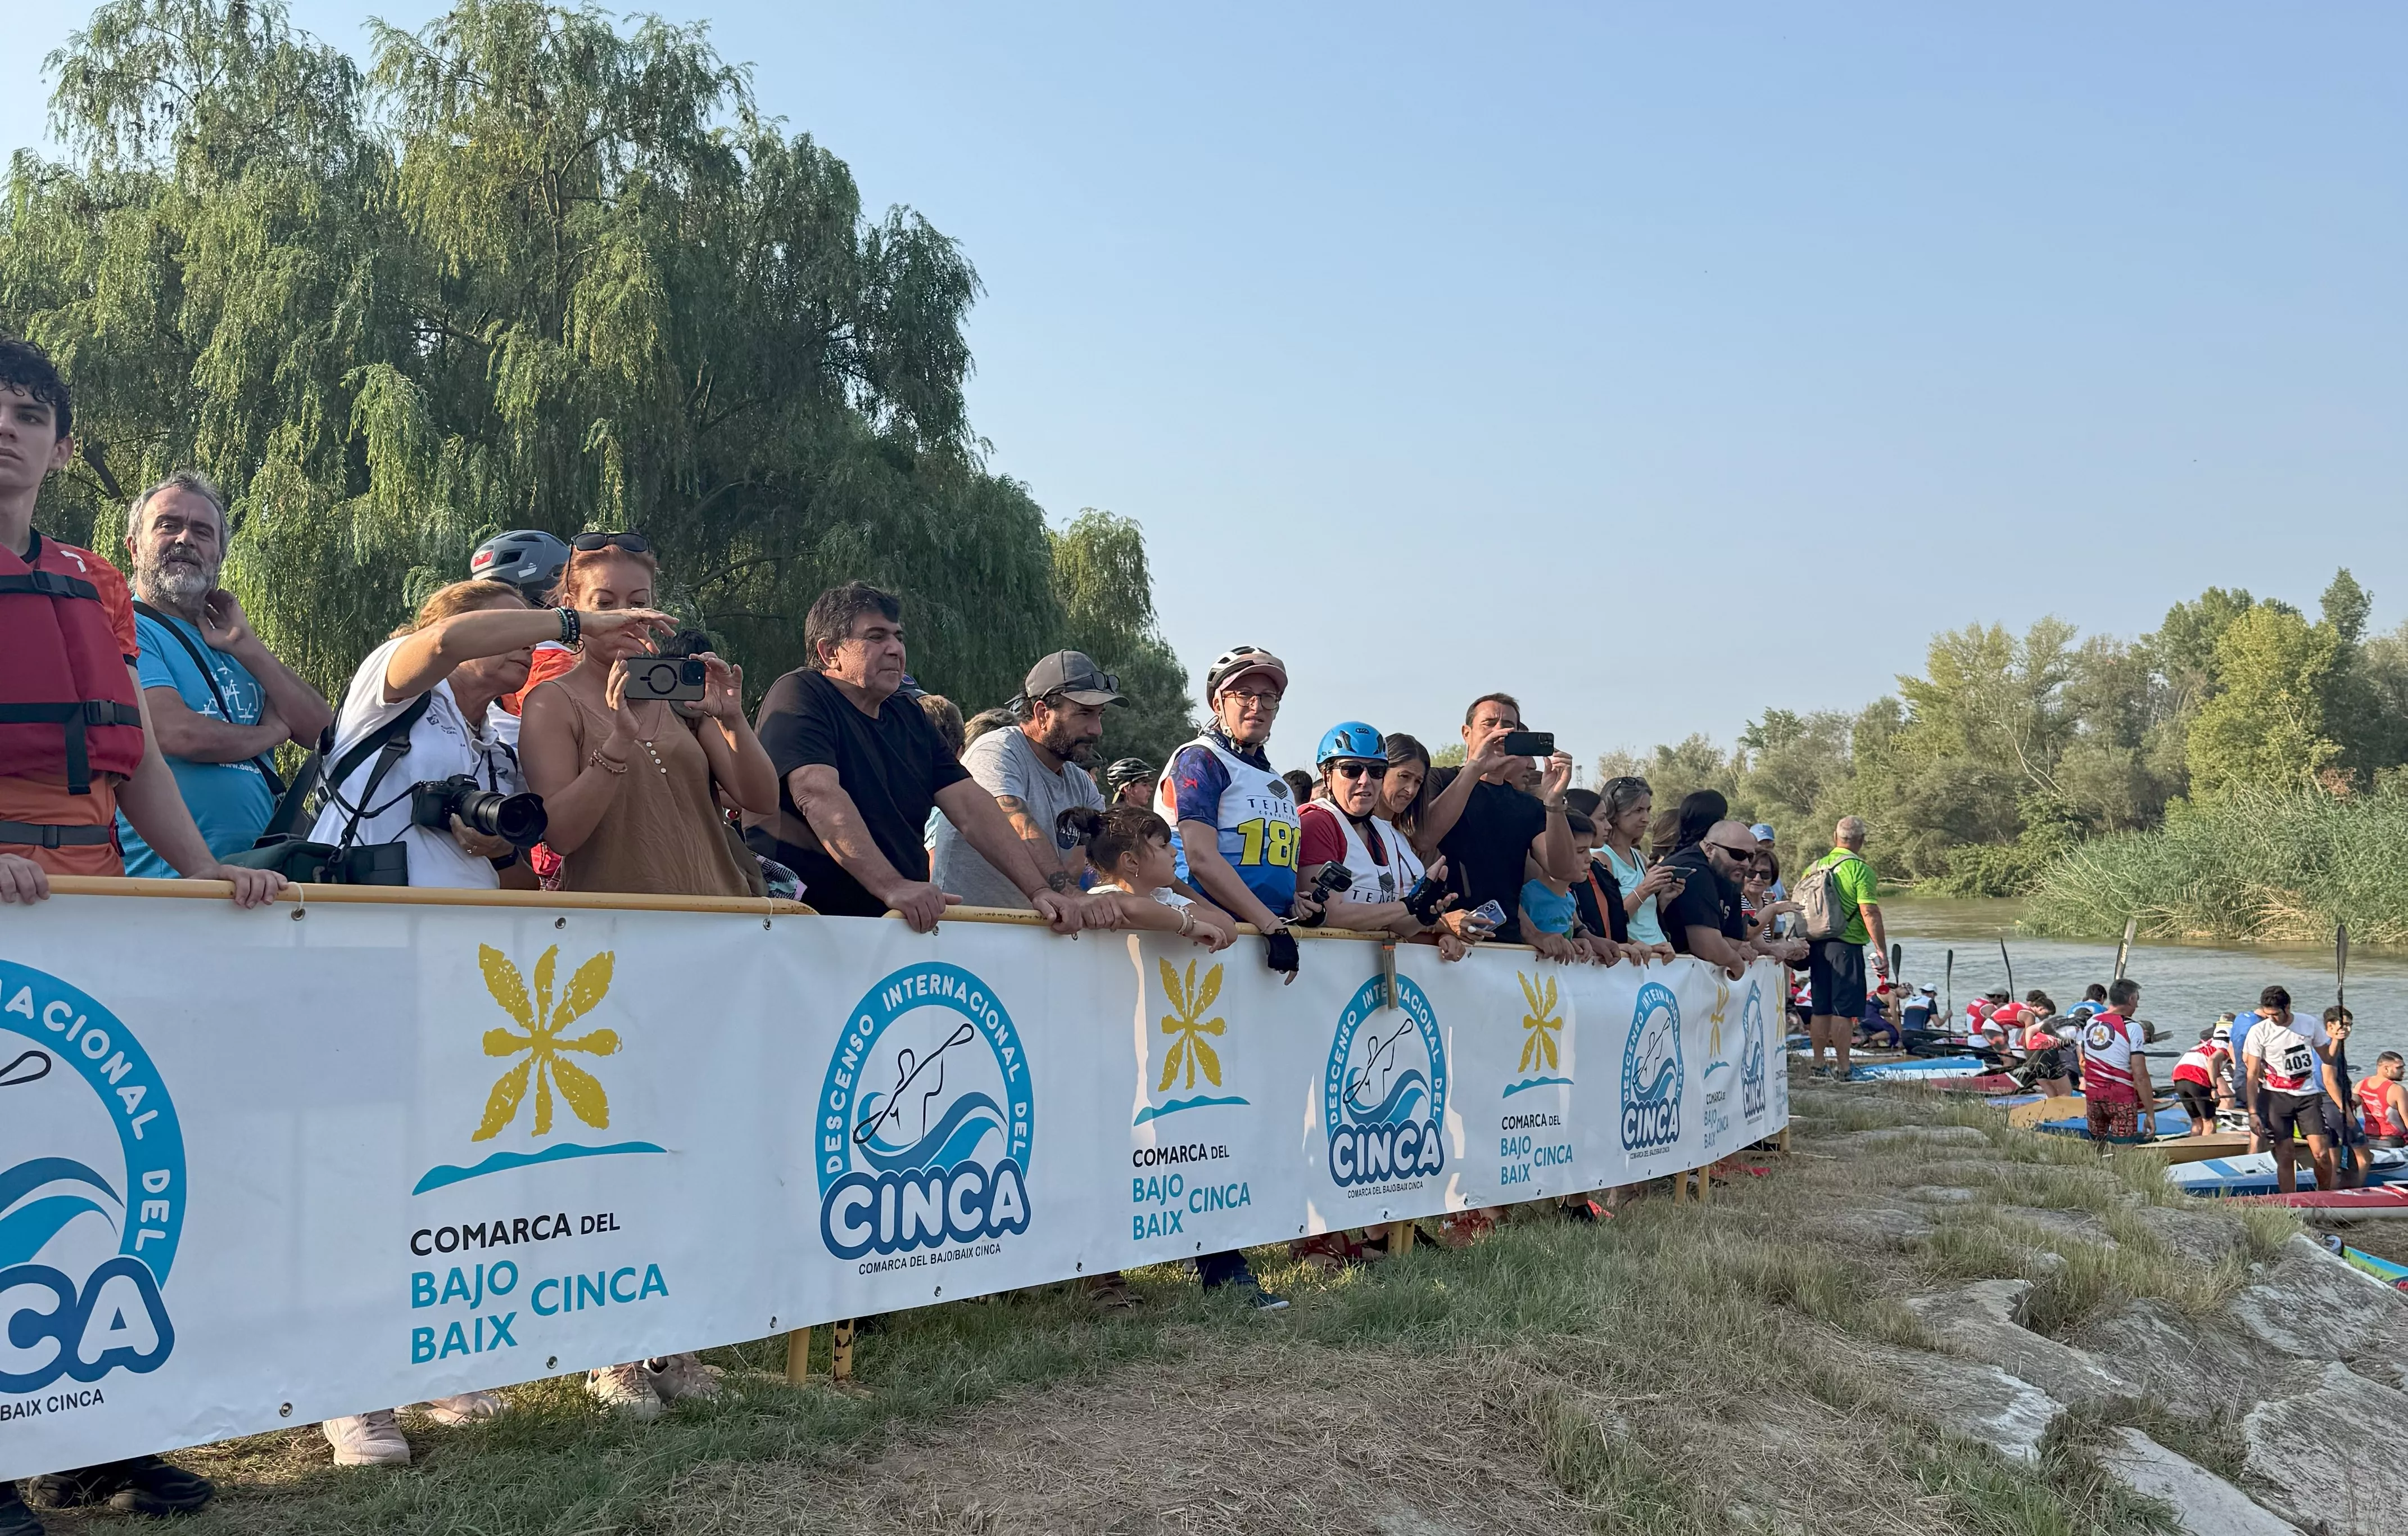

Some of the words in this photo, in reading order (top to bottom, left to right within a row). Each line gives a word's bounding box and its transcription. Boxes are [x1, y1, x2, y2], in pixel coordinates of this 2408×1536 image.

[825, 1014, 874, 1174] DESCENSO
[882, 973, 1022, 1082] INTERNACIONAL
[1012, 1101, 1027, 1156] DEL
[1329, 1010, 1357, 1124] DESCENSO
[1362, 982, 1439, 1064] INTENACIONAL
[1433, 1077, 1443, 1118] DEL
[1623, 1011, 1644, 1101] DESCENSO
[2285, 1053, 2312, 1071] 403
[0, 979, 159, 1141] ACIONAL
[135, 1168, 170, 1252] DEL
[1501, 1113, 1547, 1131] COMARCA
[1549, 1115, 1561, 1126] DEL
[1622, 1102, 1680, 1145] CINCA
[1704, 1108, 1717, 1128] BAJO
[1132, 1143, 1208, 1168] COMARCA
[1211, 1145, 1230, 1159] DEL
[1332, 1126, 1441, 1180] CINCA
[1501, 1135, 1531, 1160] BAJO
[1534, 1144, 1573, 1167] CINCA
[1133, 1173, 1184, 1206] BAJO
[1188, 1182, 1251, 1214] CINCA
[1347, 1187, 1372, 1199] COMARCA
[1408, 1181, 1424, 1190] CINCA
[1501, 1163, 1531, 1185] BAIX
[829, 1169, 1025, 1248] CINCA
[1133, 1209, 1184, 1240] BAIX
[410, 1213, 572, 1256] COMARCA
[580, 1212, 621, 1235] DEL
[859, 1258, 907, 1275] COMARCA
[910, 1255, 928, 1267] DEL
[975, 1243, 1001, 1257] CINCA
[411, 1259, 519, 1310] BAJO
[531, 1263, 669, 1317] CINCA
[411, 1311, 518, 1365] BAIX
[0, 1399, 42, 1421] BAIX
[47, 1389, 104, 1412] CINCA
